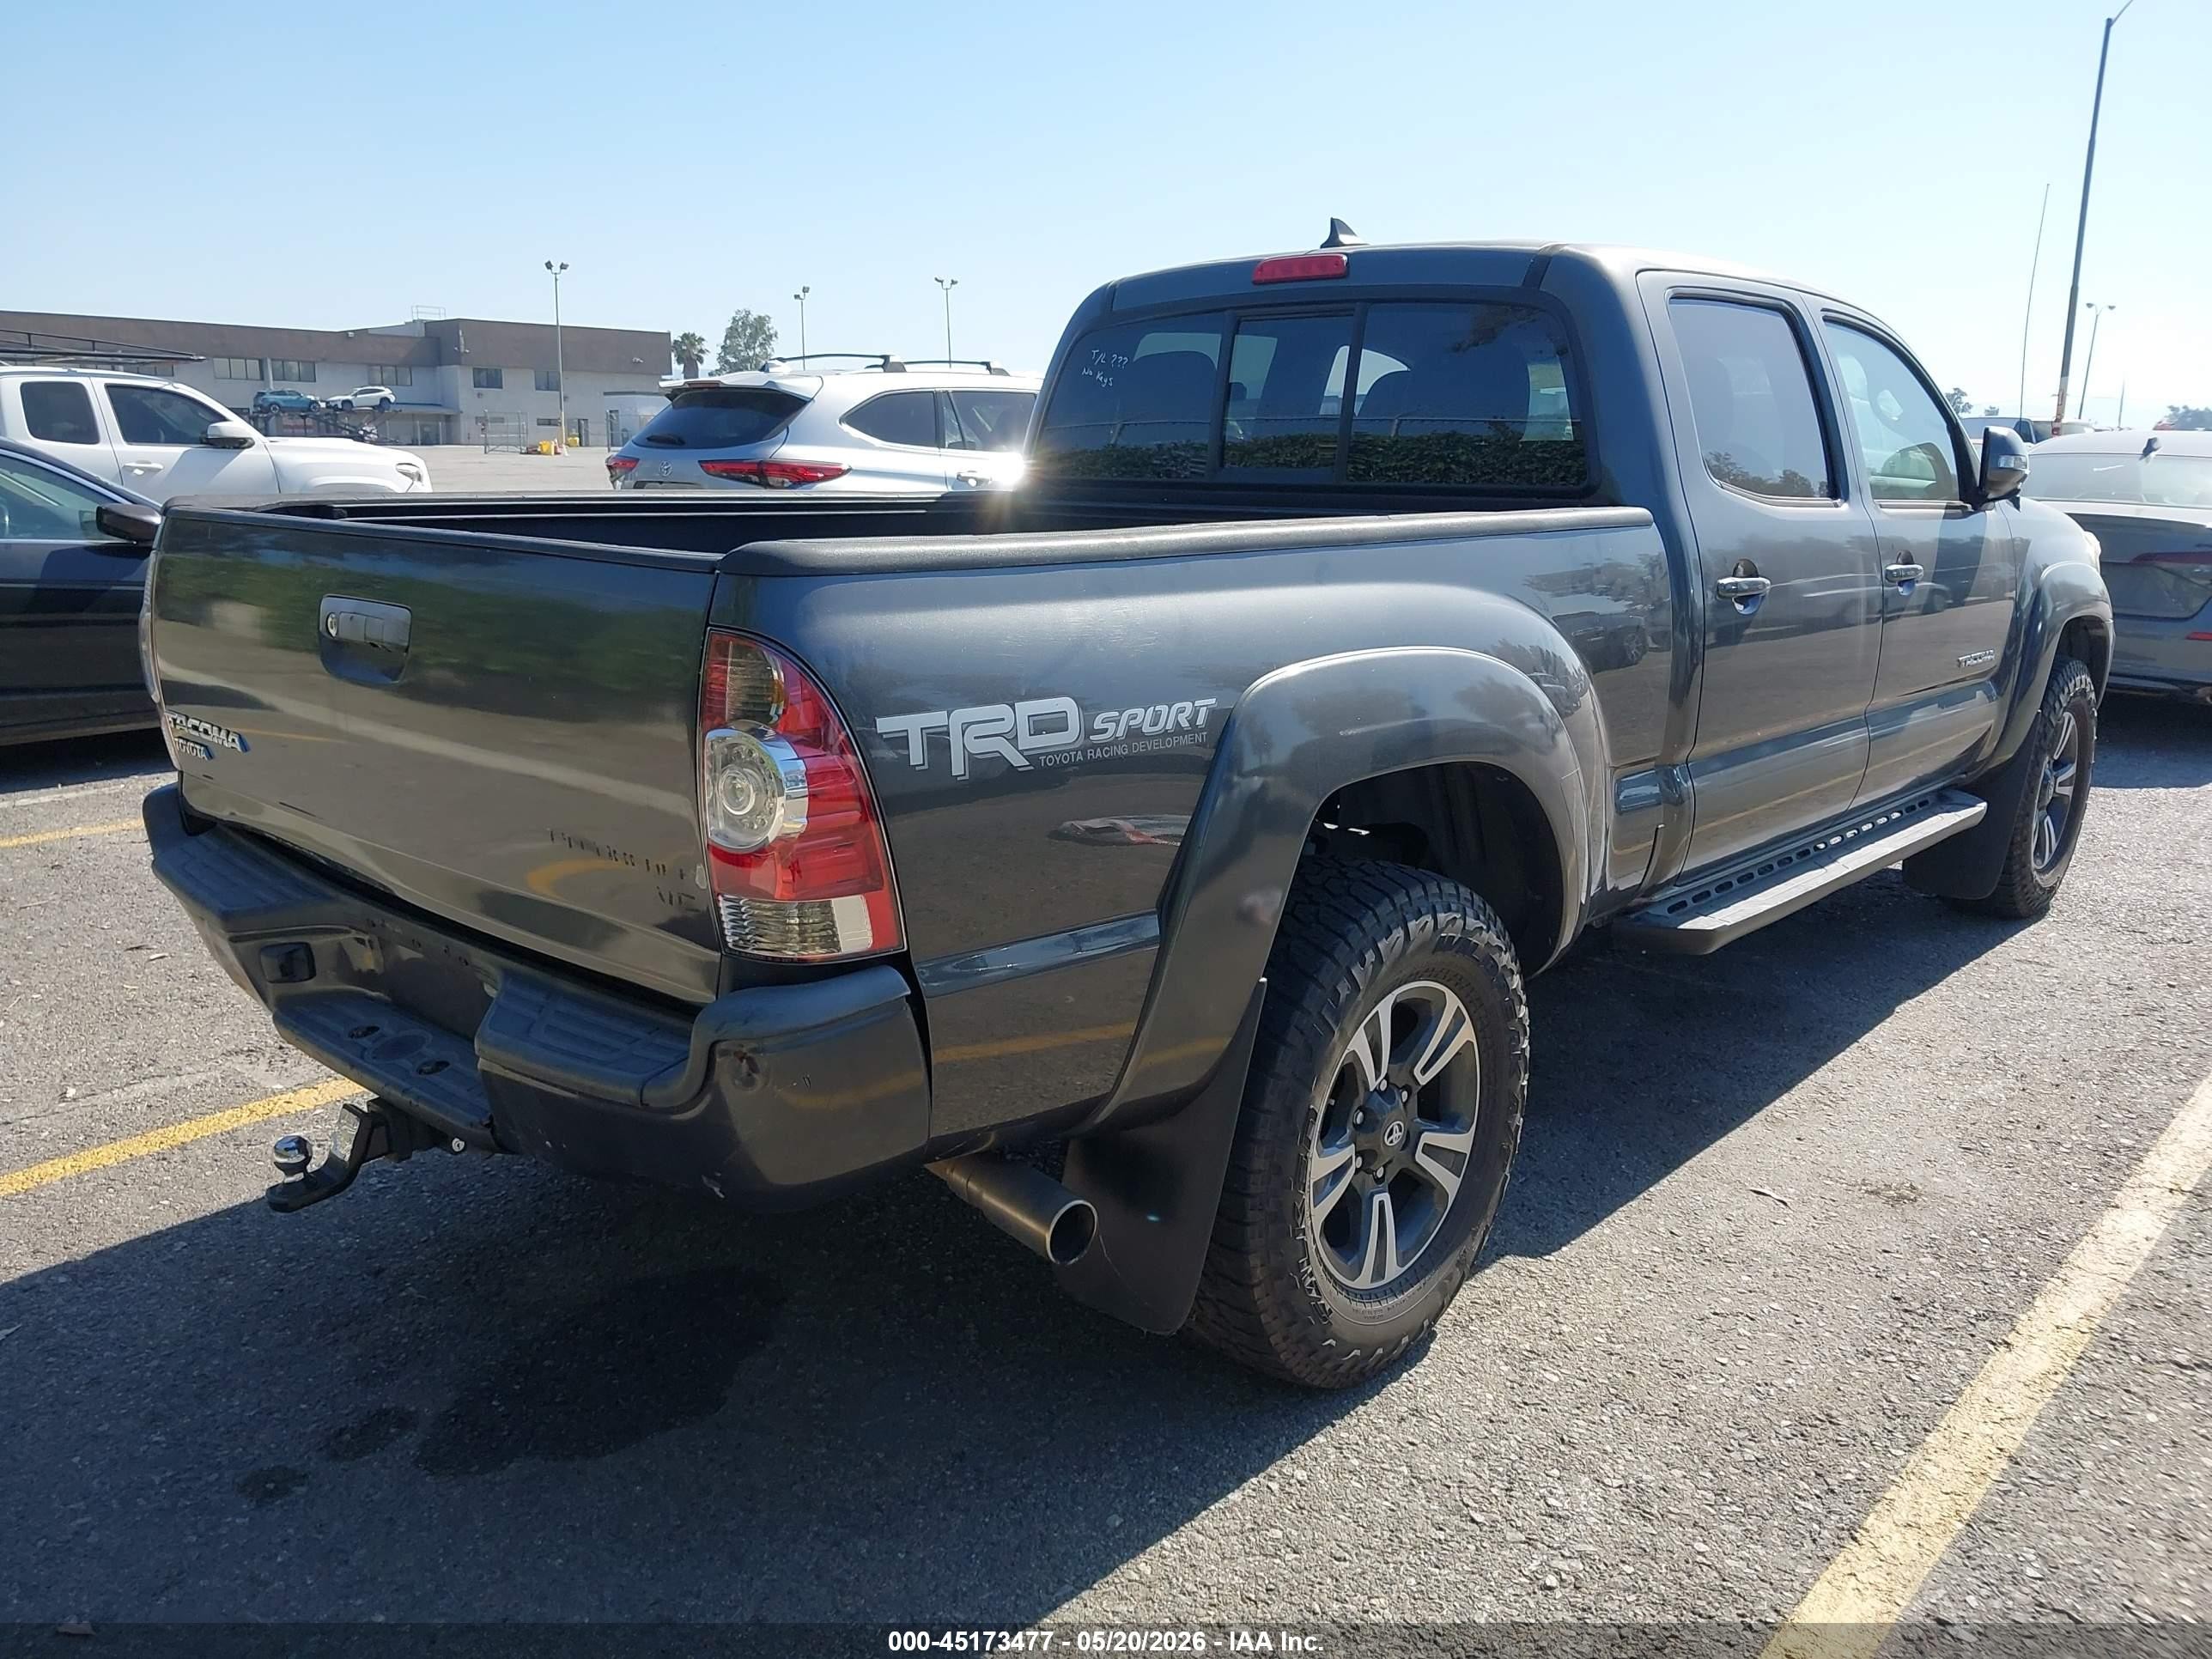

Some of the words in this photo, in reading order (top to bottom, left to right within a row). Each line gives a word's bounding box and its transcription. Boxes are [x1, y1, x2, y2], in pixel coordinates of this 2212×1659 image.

[1111, 354, 1128, 369] ???
[164, 709, 247, 752] TACOMA
[173, 736, 212, 761] TOYOTA
[876, 696, 1085, 780] TRD
[1090, 697, 1218, 744] SPORT
[1039, 751, 1084, 768] TOYOTA
[1087, 742, 1128, 763] RACING
[1132, 732, 1208, 755] DEVELOPMENT
